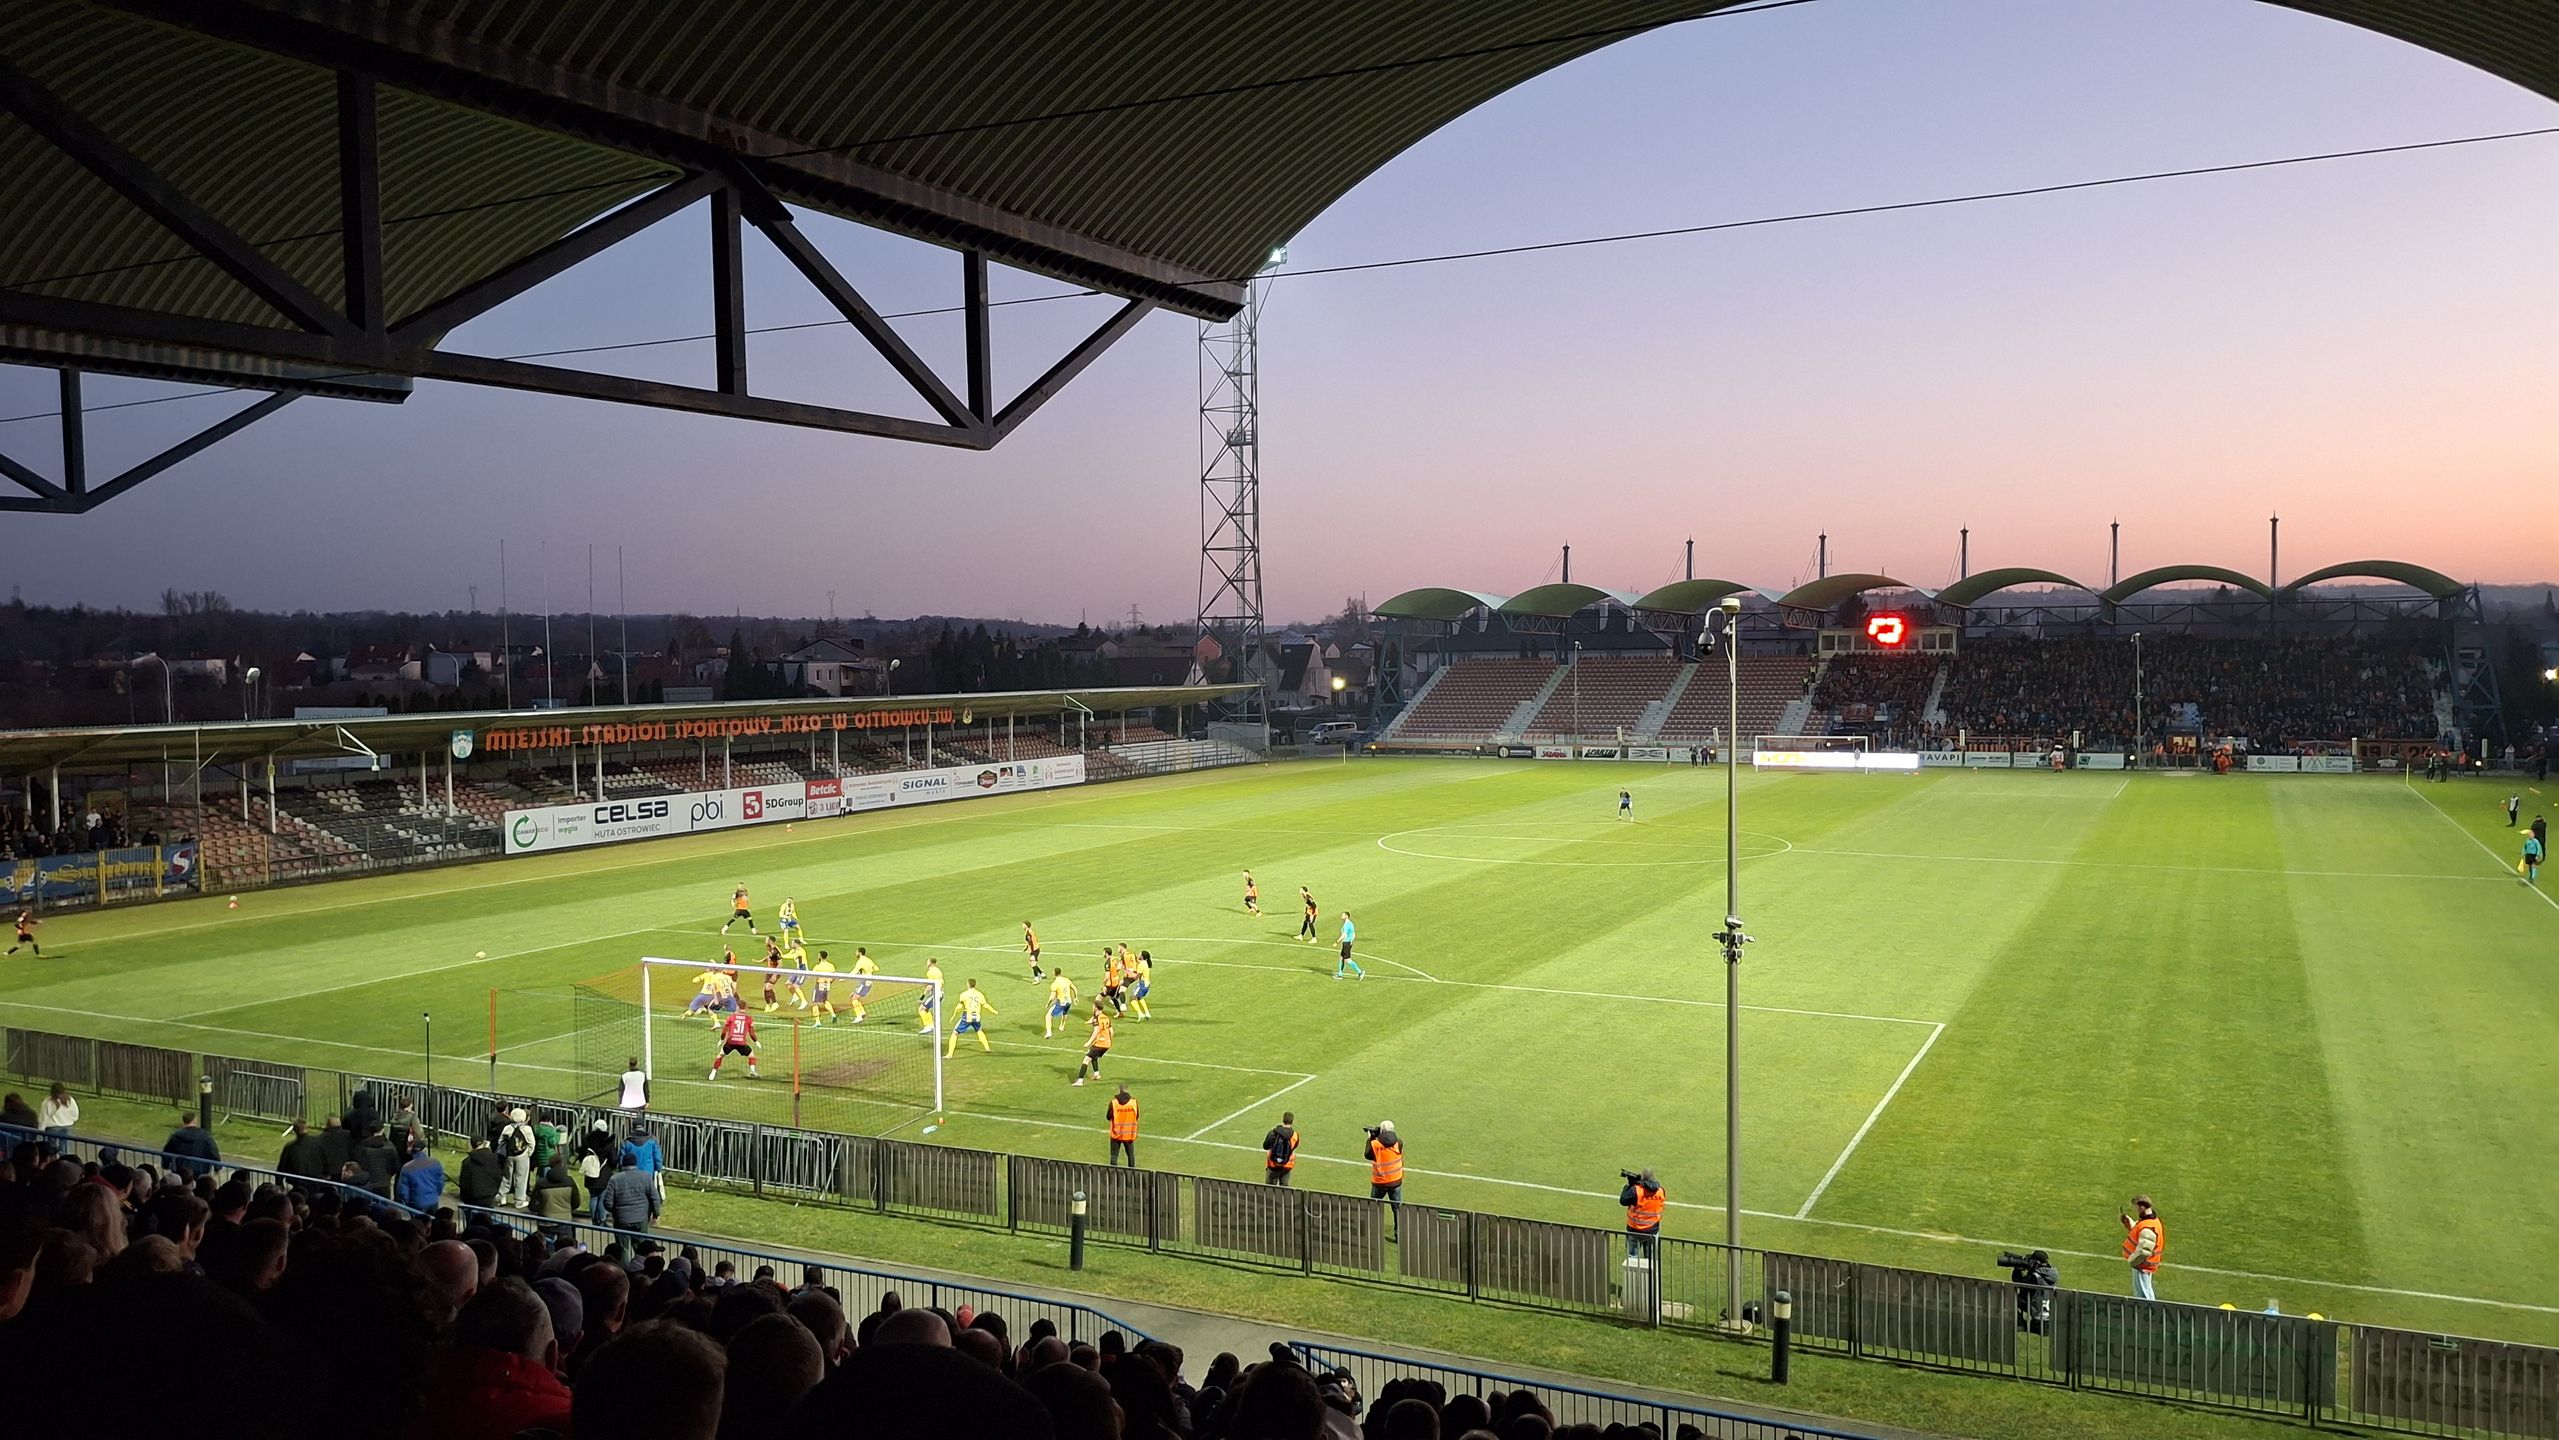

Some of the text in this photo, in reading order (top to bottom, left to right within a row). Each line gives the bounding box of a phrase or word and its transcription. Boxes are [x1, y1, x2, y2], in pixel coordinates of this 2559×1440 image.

[485, 727, 571, 751] MIEJSKI
[582, 722, 667, 745] STADION
[675, 716, 771, 739] SPORTOWY
[832, 713, 848, 730] W
[854, 708, 930, 729] OSTROWCU
[810, 783, 837, 796] Betclic
[902, 777, 948, 790] SIGNAL
[765, 797, 804, 810] 5DGroup
[594, 824, 661, 839] HUTA OSTROWIEC
[733, 1020, 745, 1034] 31
